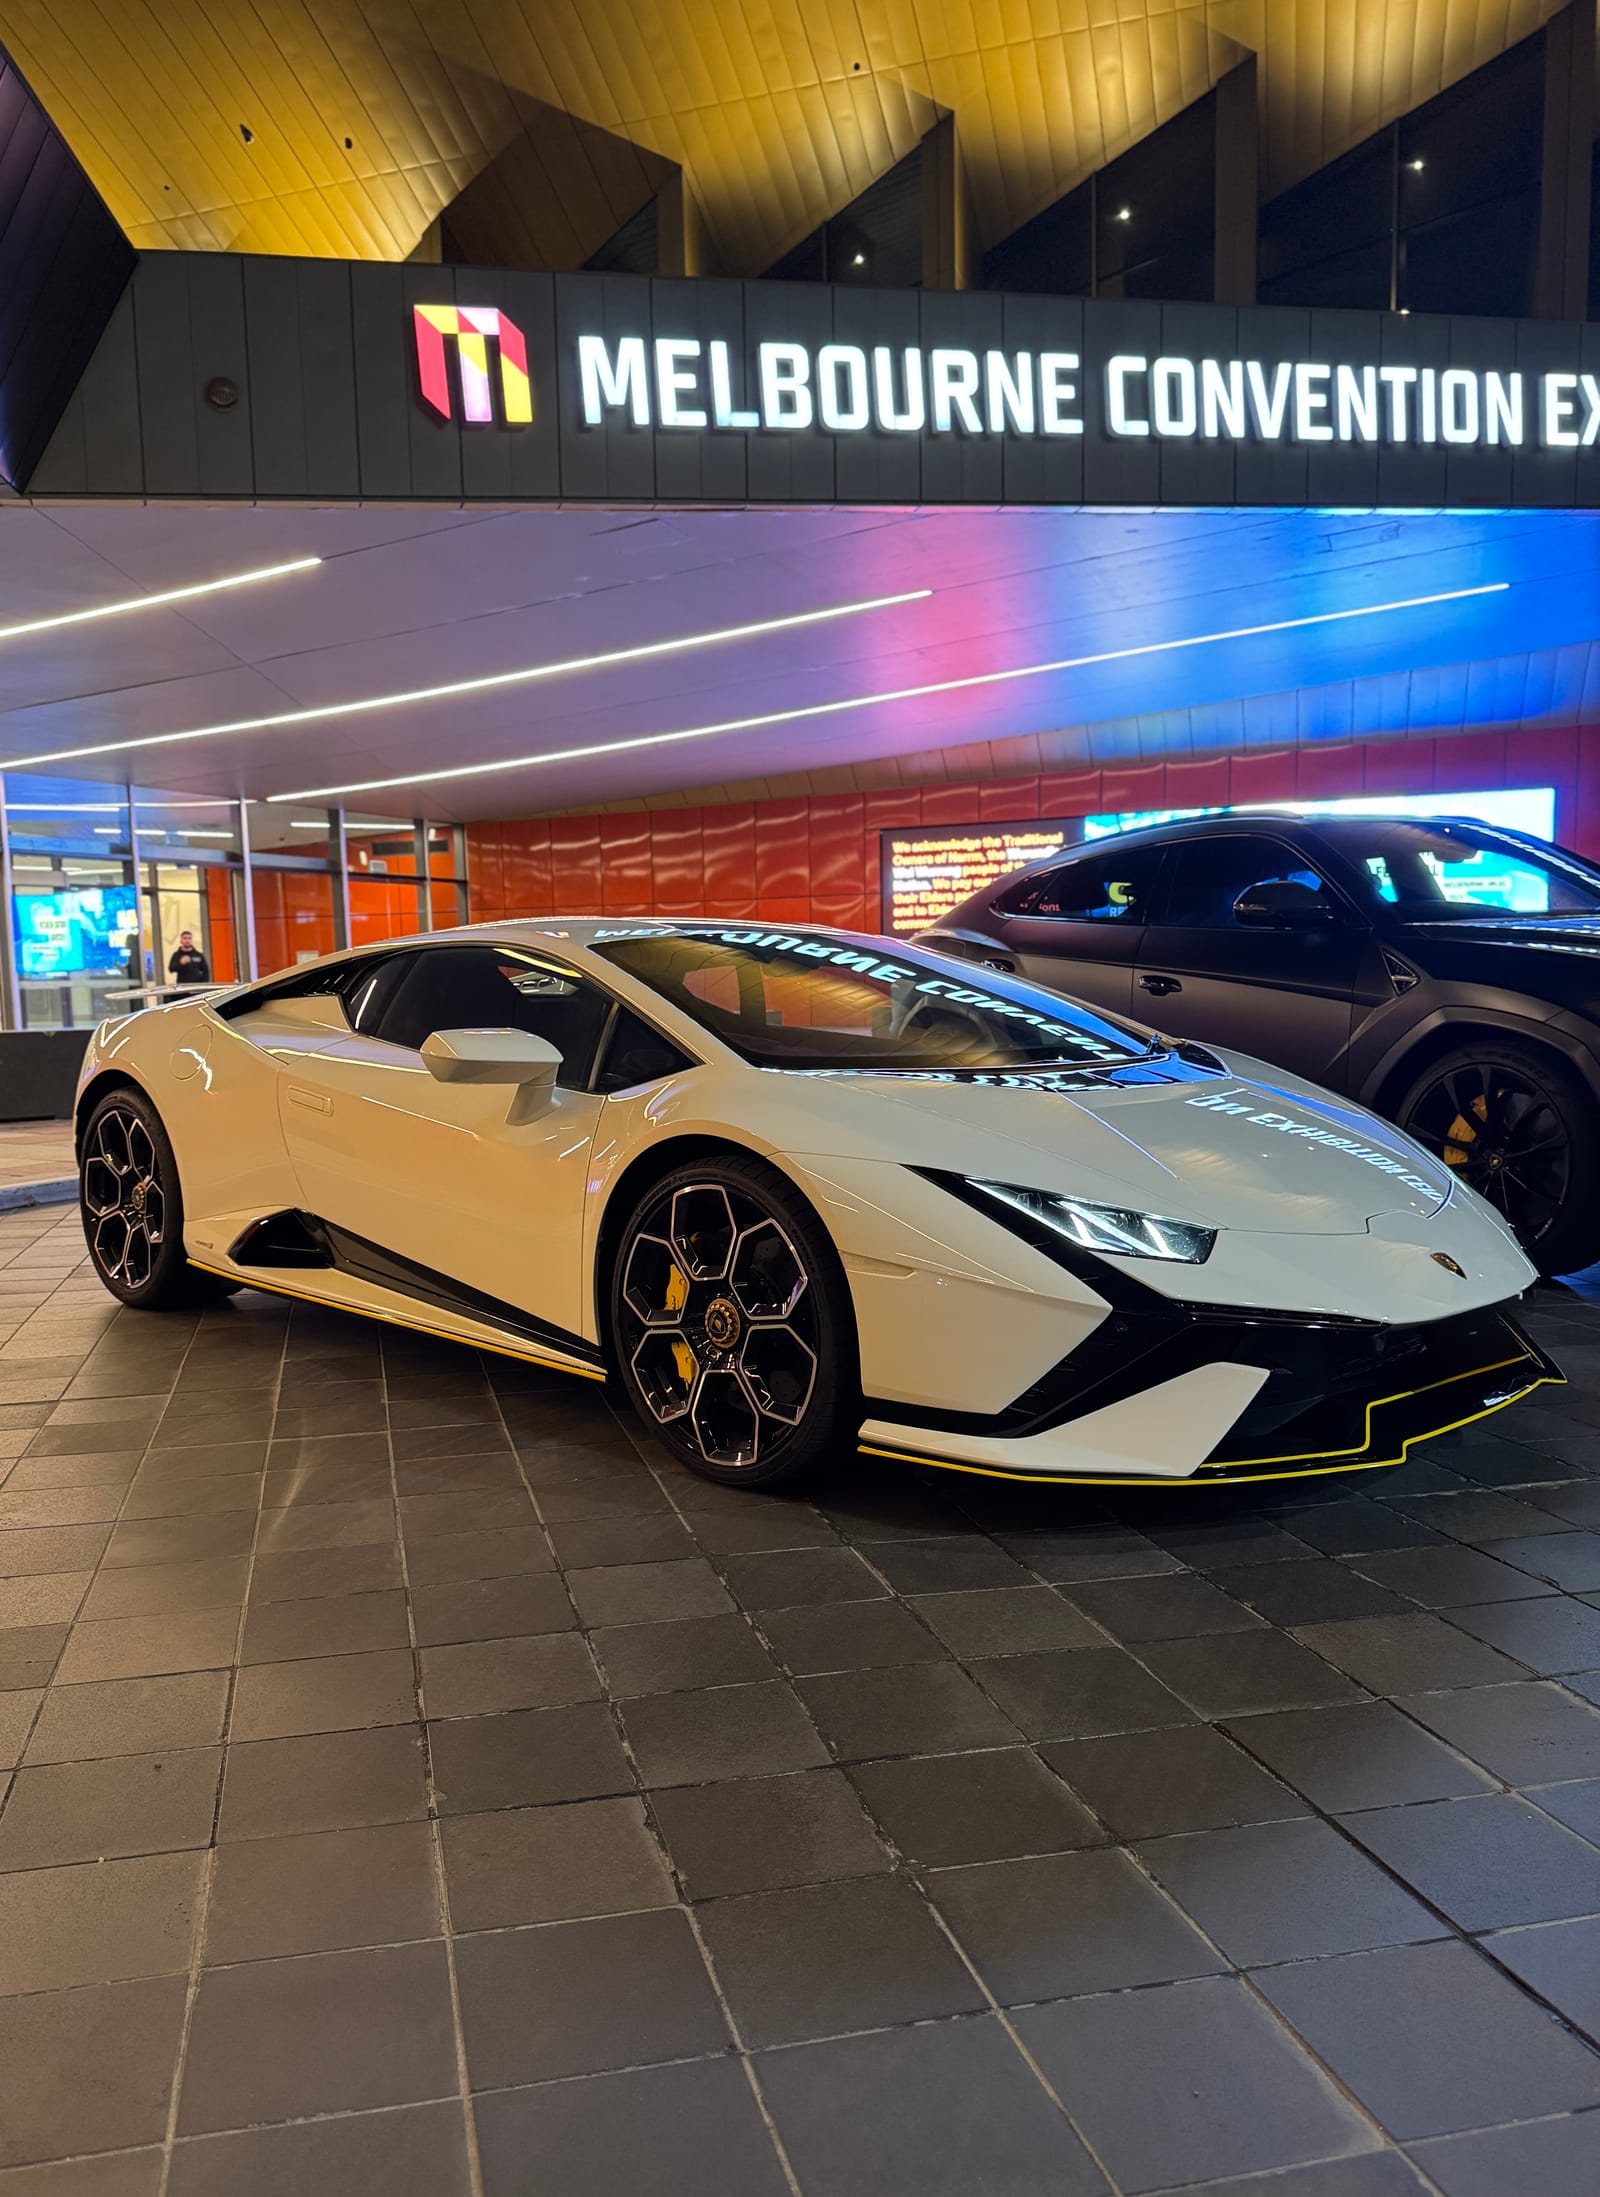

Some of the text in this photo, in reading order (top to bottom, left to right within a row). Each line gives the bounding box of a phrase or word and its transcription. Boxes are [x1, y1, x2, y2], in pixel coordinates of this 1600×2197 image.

[578, 336, 1084, 435] MELBOURNE
[1107, 355, 1523, 445] CONVENTION
[892, 832, 1063, 853] We acknowledge the Traditional
[892, 854, 933, 865] Owners
[935, 852, 947, 863] of
[986, 849, 1006, 860] the
[962, 864, 1000, 876] people
[1000, 861, 1013, 873] of
[932, 878, 951, 889] We
[951, 878, 972, 890] pay
[892, 893, 918, 905] their
[919, 891, 954, 903] Elders
[892, 906, 914, 917] and
[915, 905, 927, 916] to
